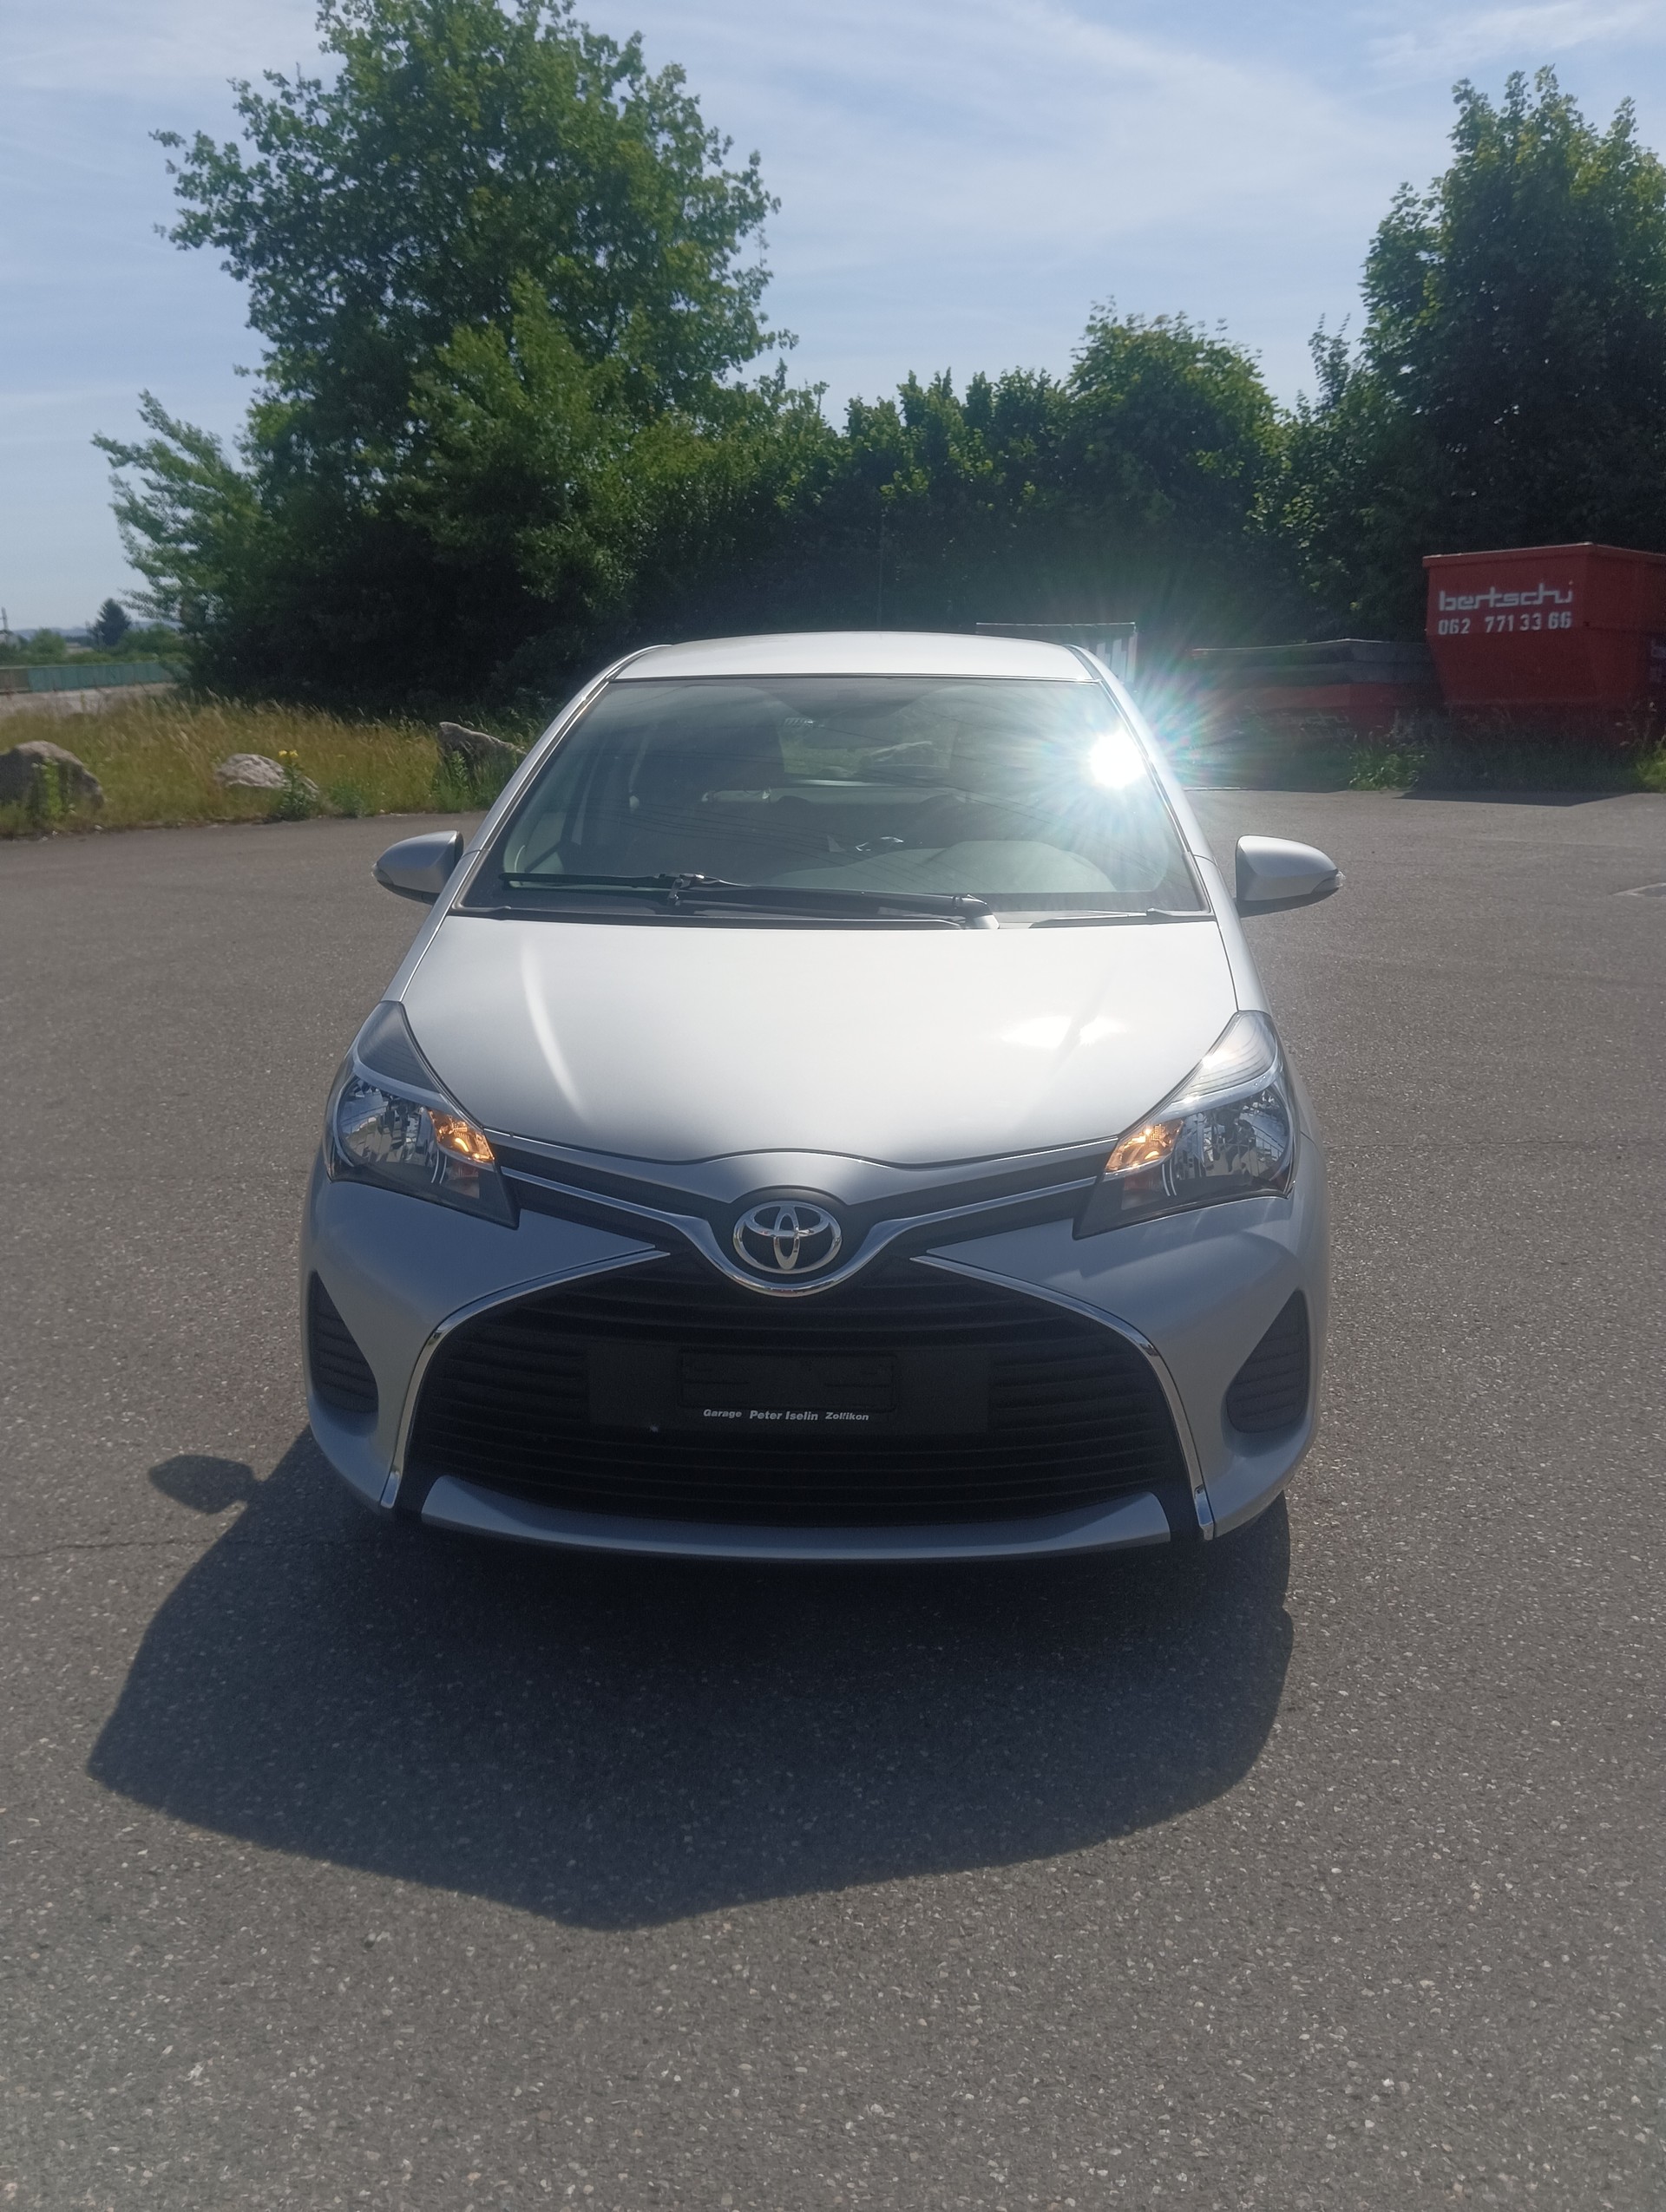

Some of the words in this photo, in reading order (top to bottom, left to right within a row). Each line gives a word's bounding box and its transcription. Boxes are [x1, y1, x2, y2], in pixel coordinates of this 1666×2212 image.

[1439, 582, 1573, 611] bertschi
[1438, 618, 1470, 635] 062
[1485, 615, 1514, 633] 771
[1519, 612, 1541, 631] 33
[1548, 611, 1571, 629] 66
[703, 1409, 742, 1419] Garage
[750, 1410, 782, 1420] Peter
[785, 1410, 818, 1421] Iselin
